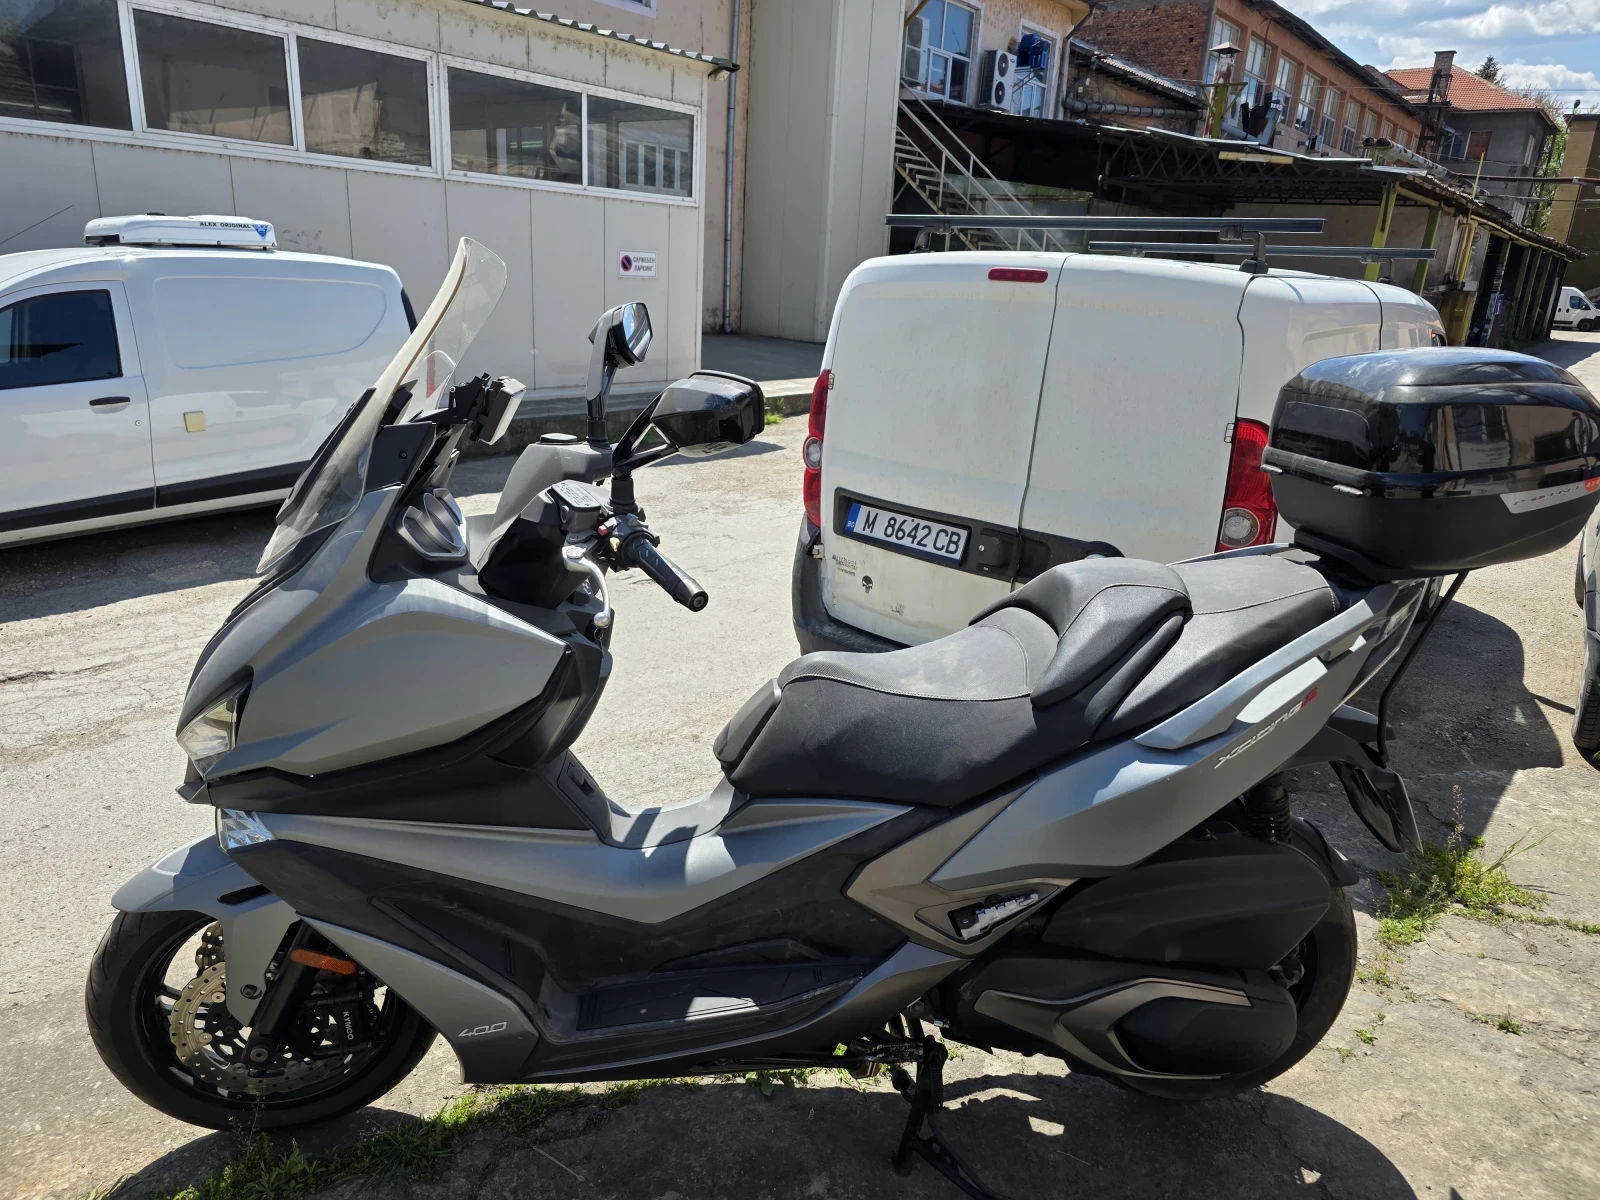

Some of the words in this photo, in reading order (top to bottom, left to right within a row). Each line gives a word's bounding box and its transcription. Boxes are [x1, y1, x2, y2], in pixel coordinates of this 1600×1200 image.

[862, 510, 879, 533] M
[343, 1011, 354, 1040] KYMCO
[458, 1021, 507, 1037] 400
